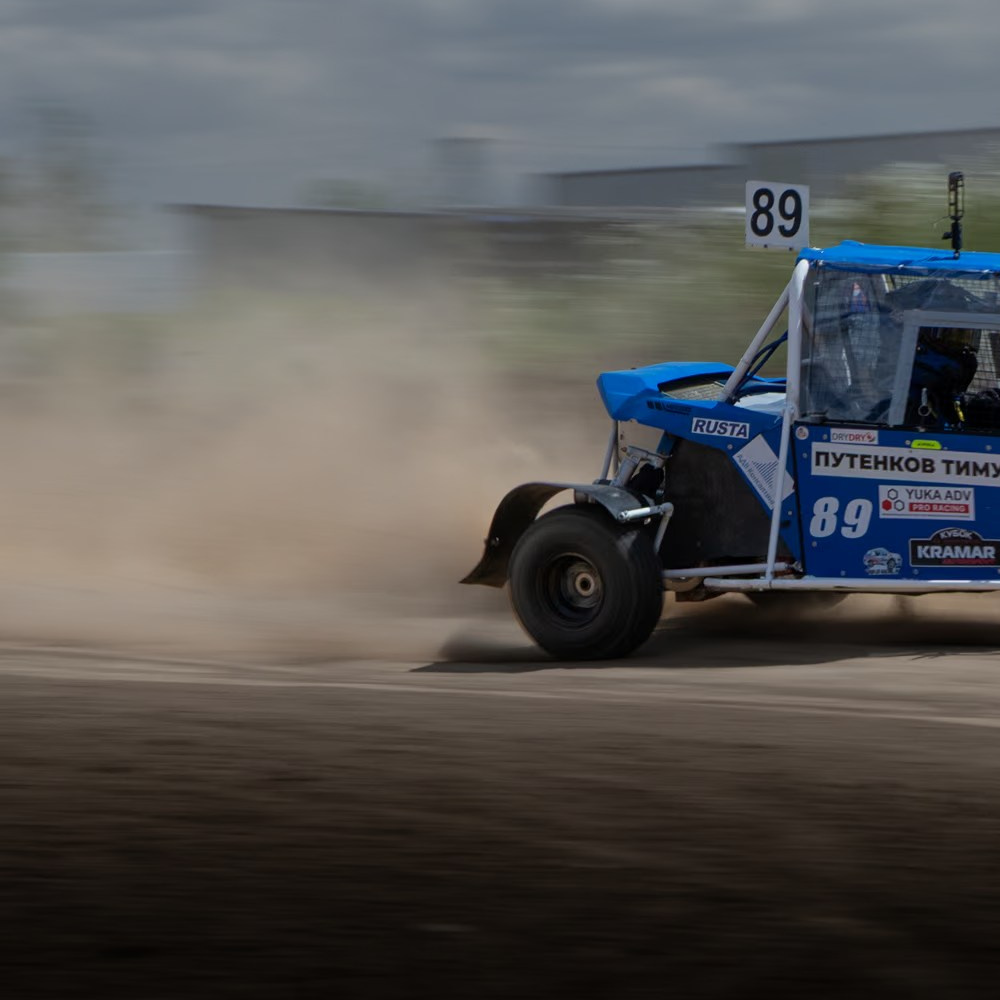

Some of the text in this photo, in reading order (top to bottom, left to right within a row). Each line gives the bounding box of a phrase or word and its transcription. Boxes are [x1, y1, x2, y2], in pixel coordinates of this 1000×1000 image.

[751, 188, 802, 238] 89
[693, 419, 748, 438] RUSTA
[831, 432, 866, 442] DRYDRY
[815, 451, 935, 474] ПУТЕНКОВ
[905, 488, 971, 501] YUKA ADV
[912, 503, 966, 513] PRO RACING
[809, 496, 873, 539] 89
[917, 545, 996, 559] KRAMAR
